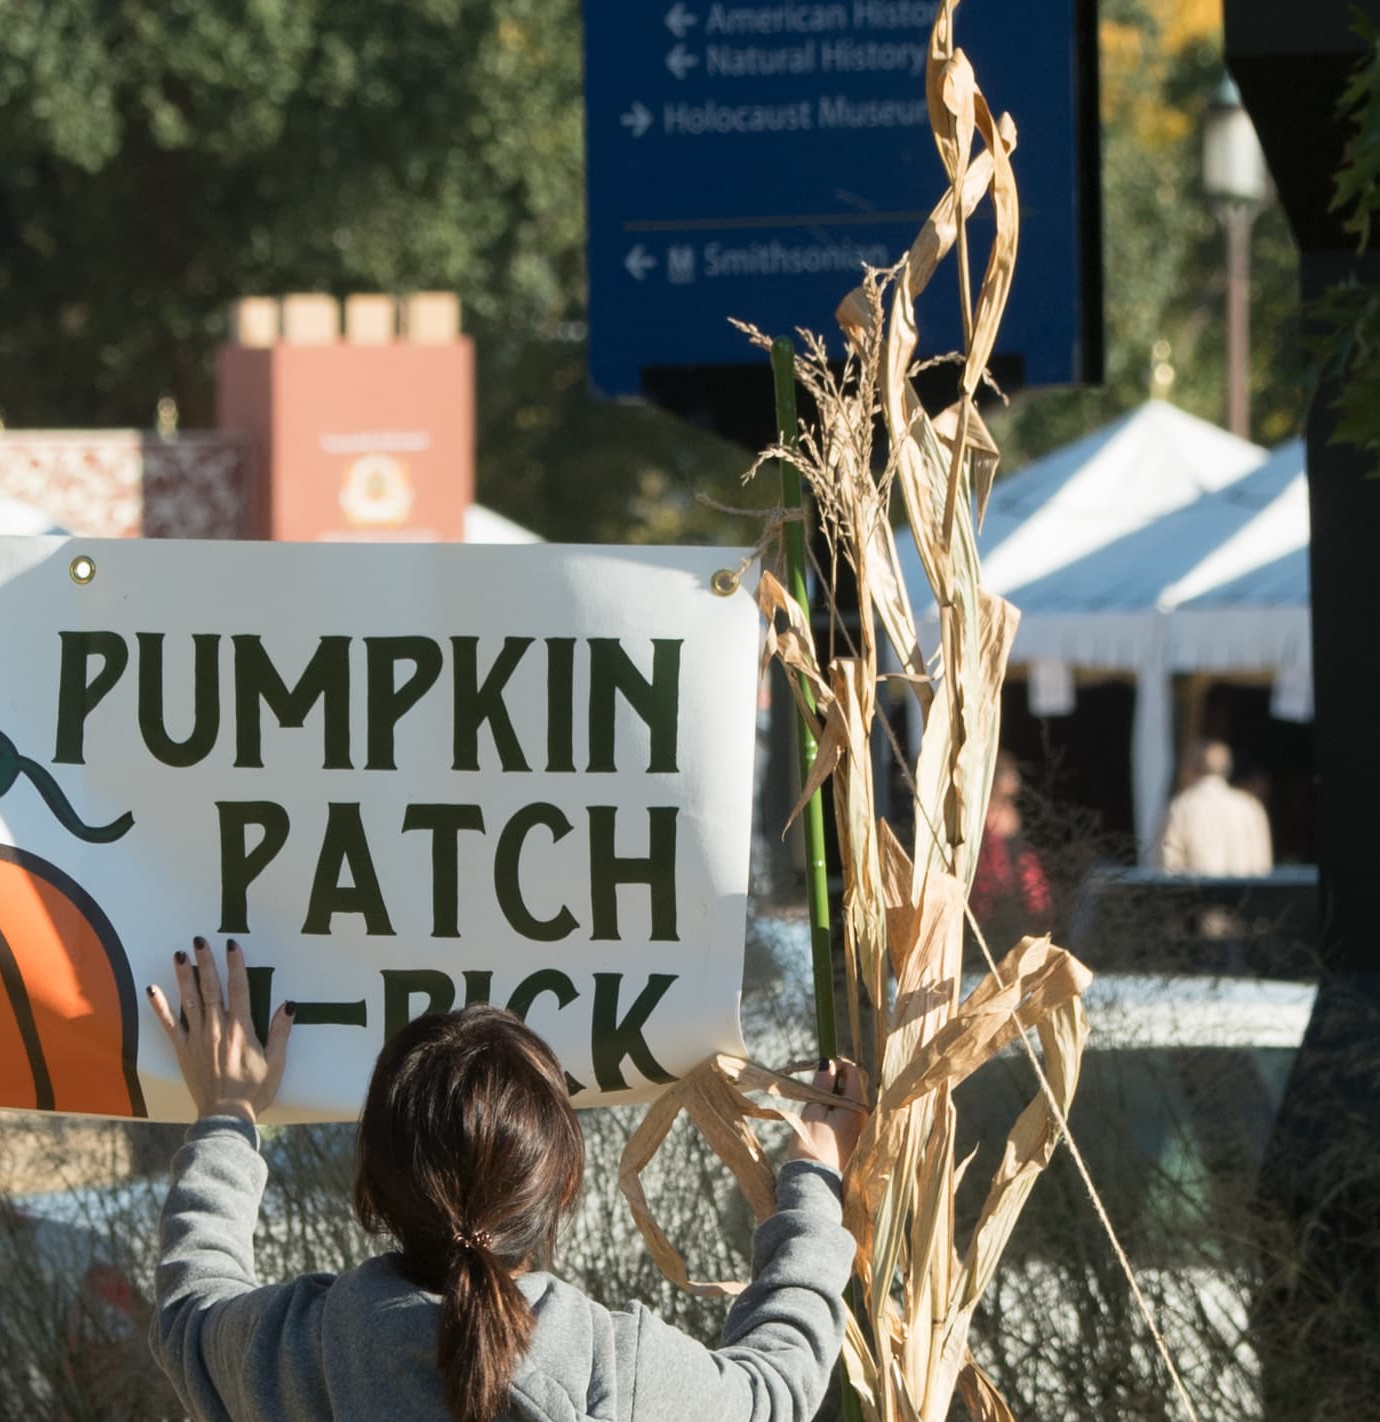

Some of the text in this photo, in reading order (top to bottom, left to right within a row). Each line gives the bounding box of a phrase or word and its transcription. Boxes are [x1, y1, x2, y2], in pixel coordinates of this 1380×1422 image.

[706, 0, 939, 34] American Histor
[708, 39, 926, 76] Natural History
[664, 101, 811, 133] Holocaust
[705, 239, 887, 276] Smithsonian
[52, 631, 685, 773] PUMPKIN
[215, 802, 681, 942] PATCH
